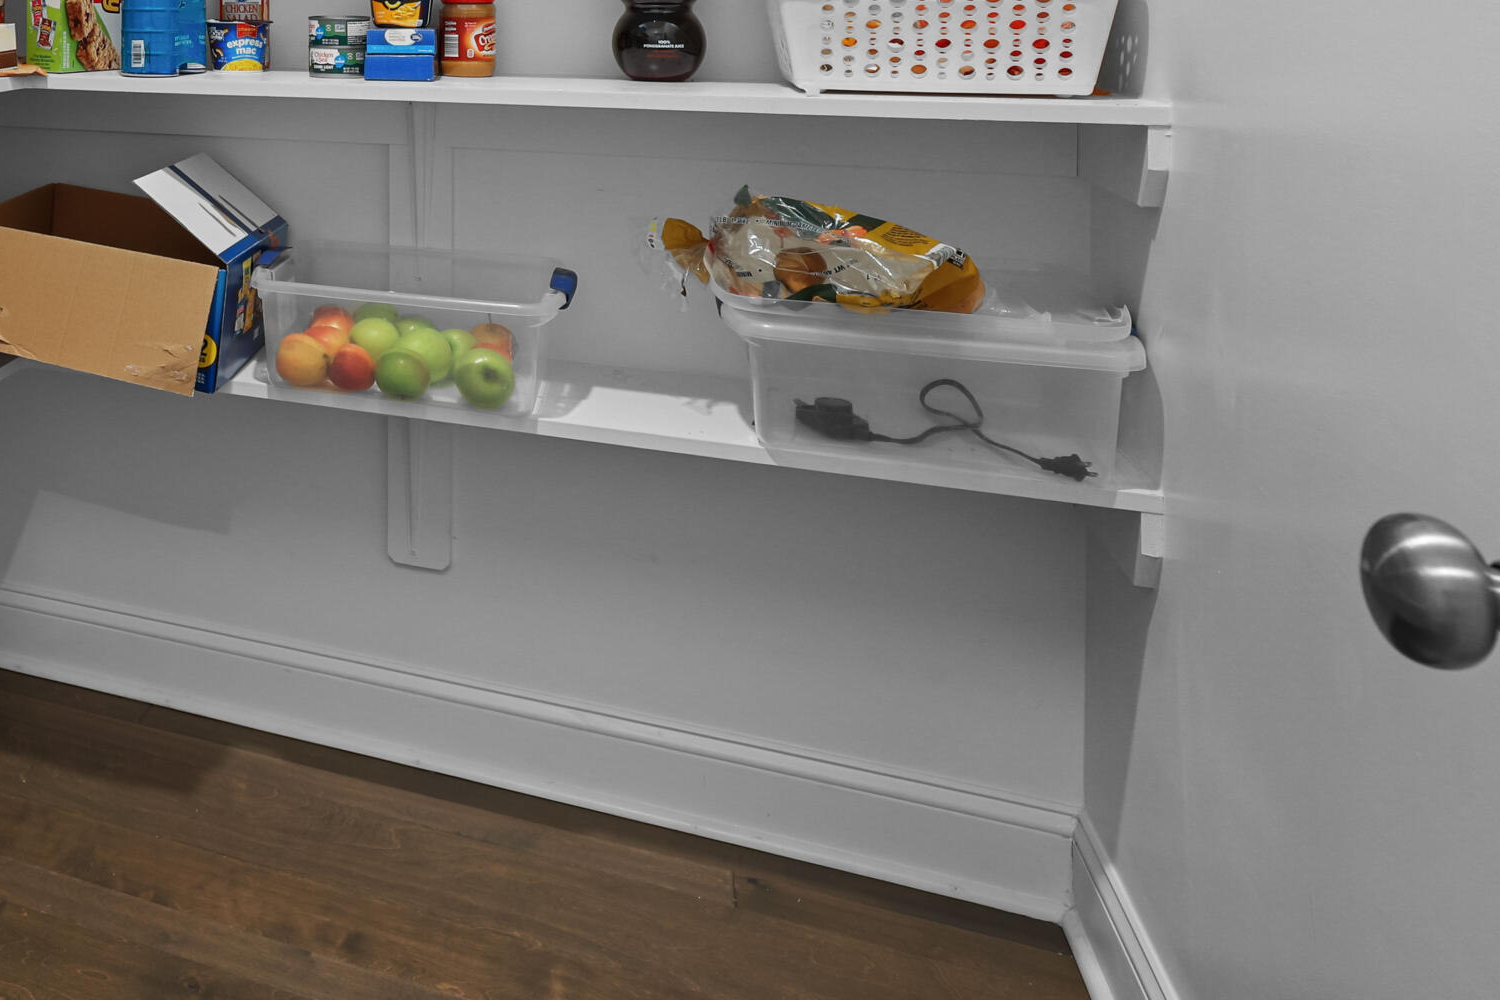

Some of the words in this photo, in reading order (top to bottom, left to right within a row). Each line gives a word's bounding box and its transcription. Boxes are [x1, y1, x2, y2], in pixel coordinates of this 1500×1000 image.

[225, 3, 258, 14] CHICKEN
[226, 38, 263, 49] express
[236, 46, 257, 55] mac
